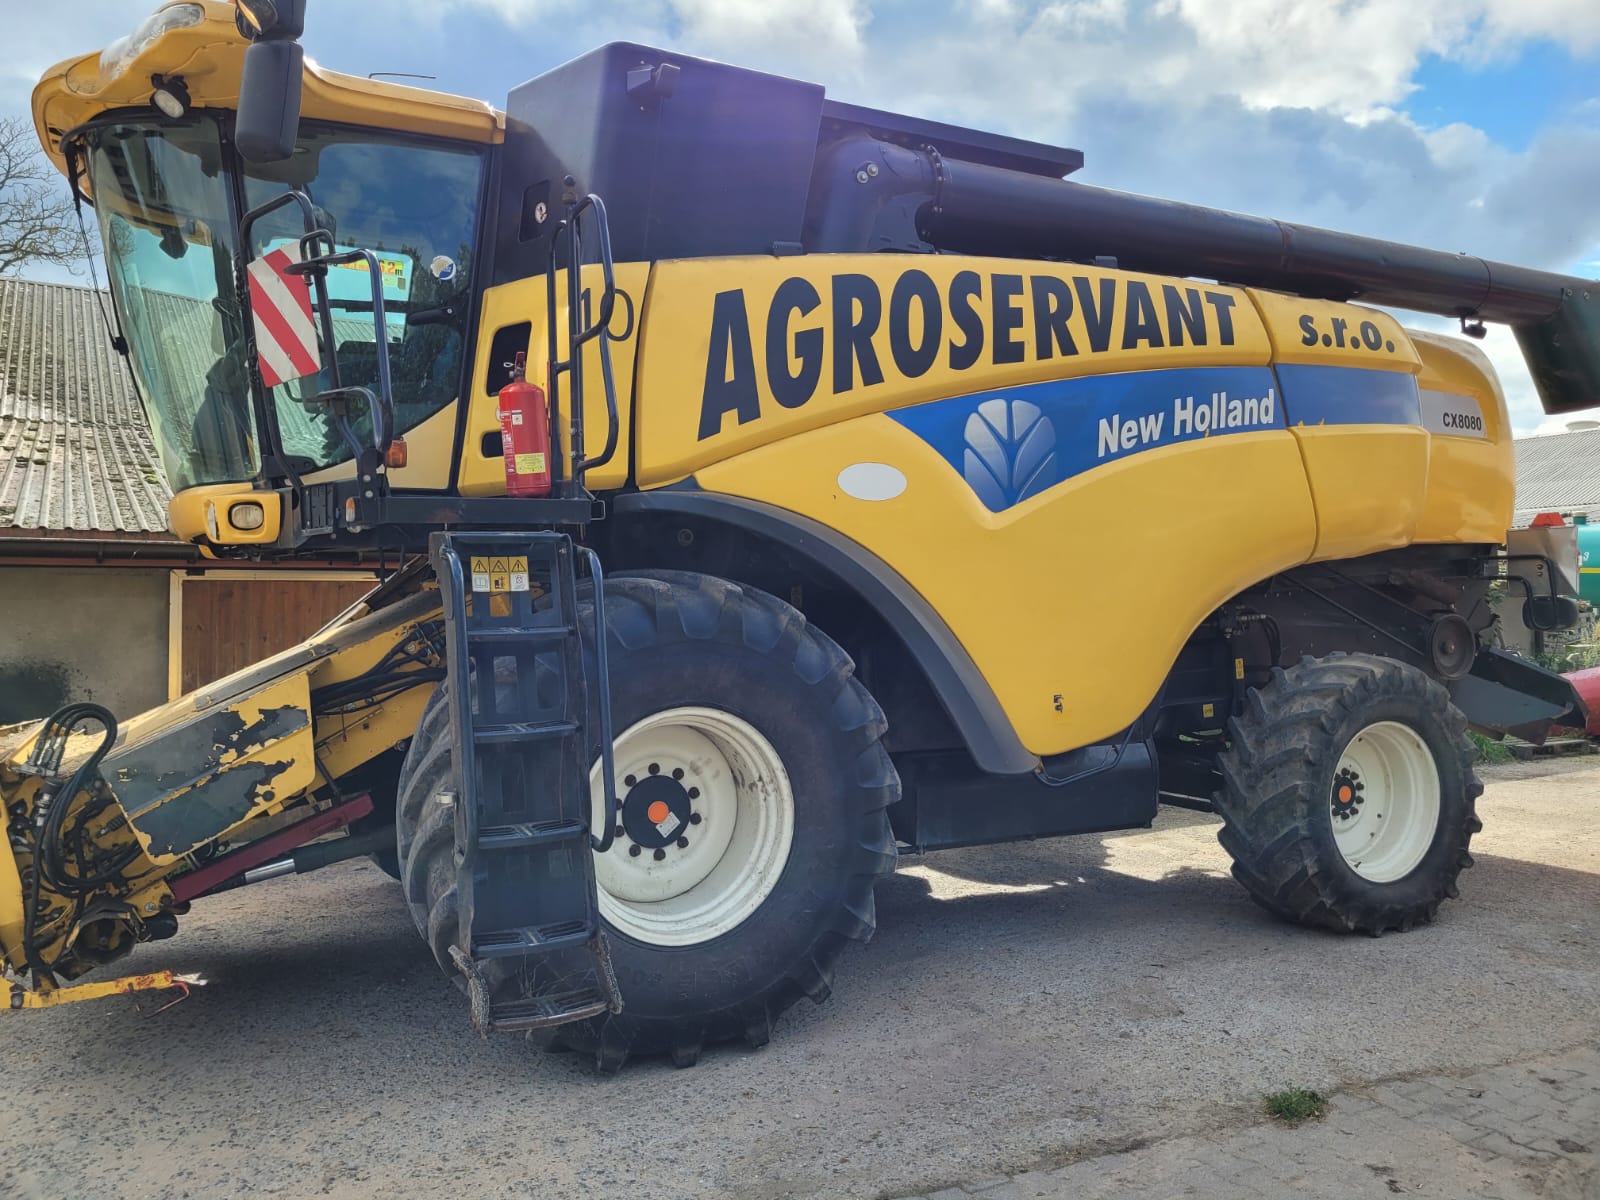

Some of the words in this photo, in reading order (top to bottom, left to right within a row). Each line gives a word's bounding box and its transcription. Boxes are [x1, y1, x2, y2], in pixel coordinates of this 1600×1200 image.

[698, 269, 1236, 442] AGROSERVANT
[1299, 314, 1395, 353] s.r.o.
[1098, 413, 1165, 458] New
[1174, 388, 1274, 436] Holland
[1442, 412, 1482, 431] CX8080
